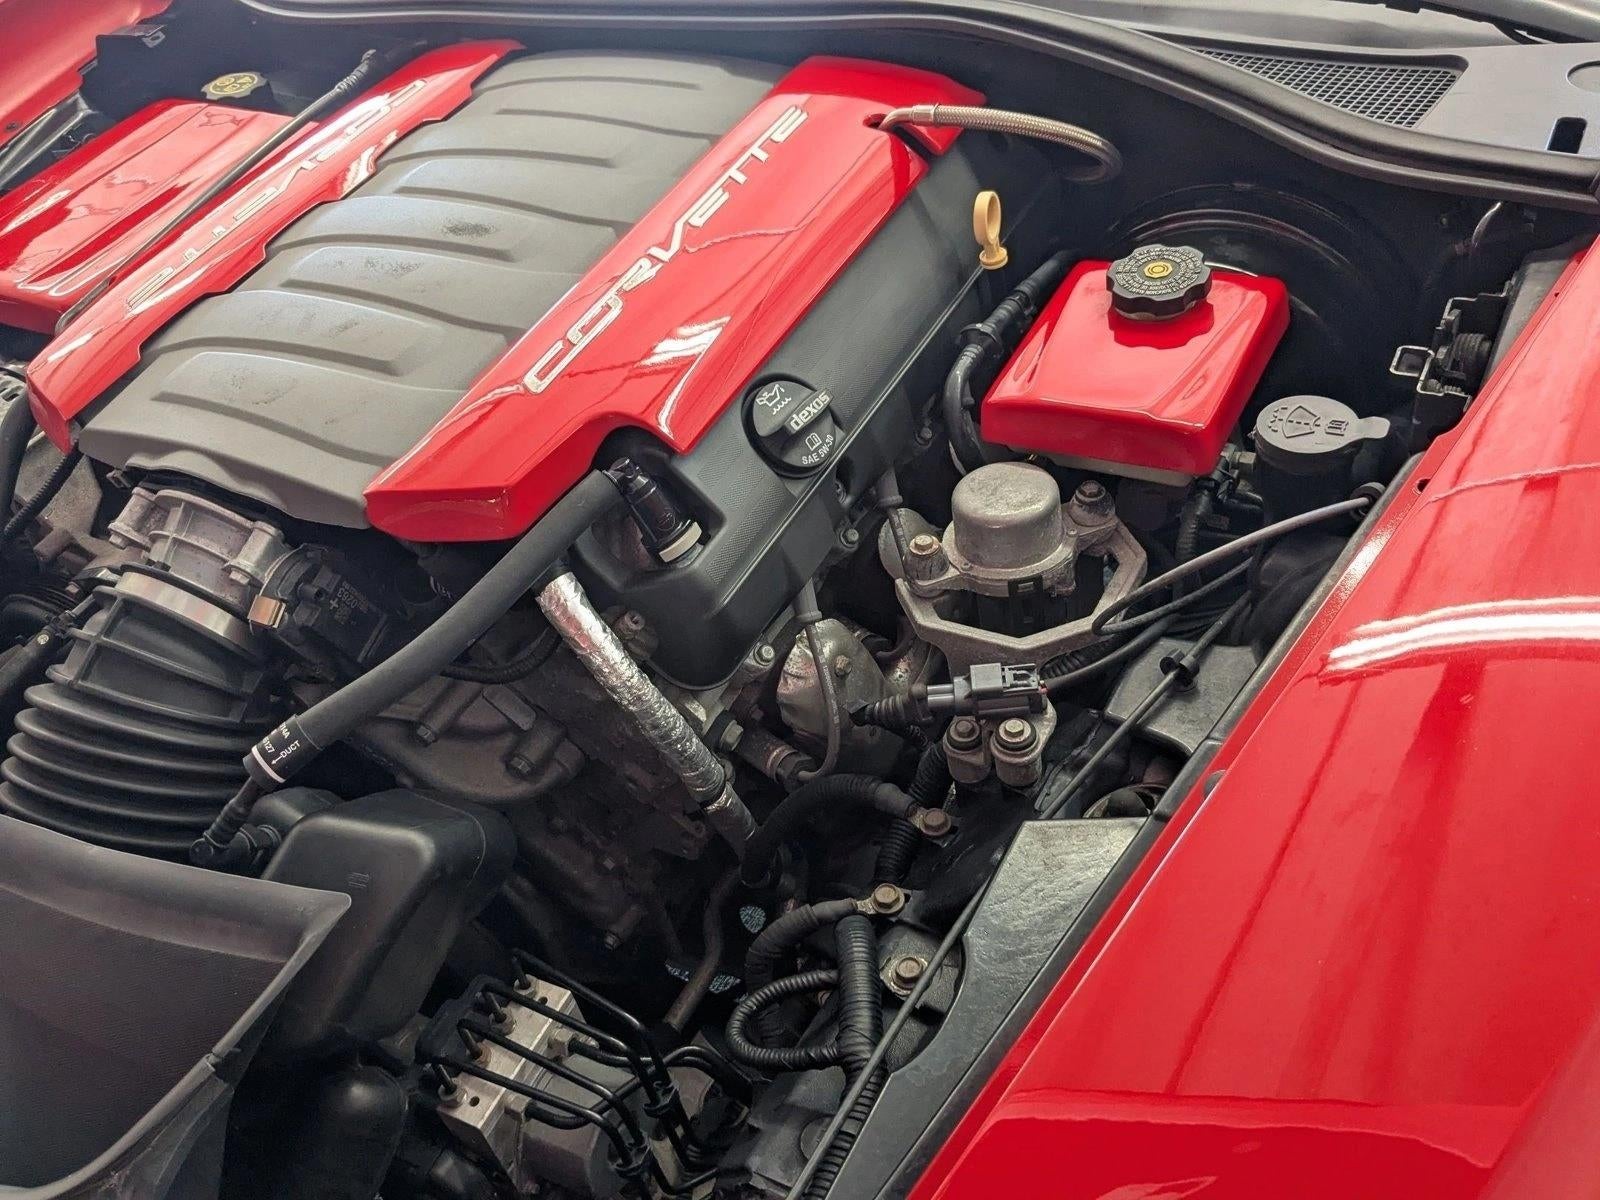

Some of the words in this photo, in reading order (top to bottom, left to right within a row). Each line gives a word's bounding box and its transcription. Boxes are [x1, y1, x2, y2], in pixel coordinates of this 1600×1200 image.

[522, 104, 809, 394] CORVETTE
[789, 390, 830, 431] dexos
[801, 454, 820, 465] SAE
[818, 434, 834, 458] 5W-30
[280, 740, 301, 758] DUCT
